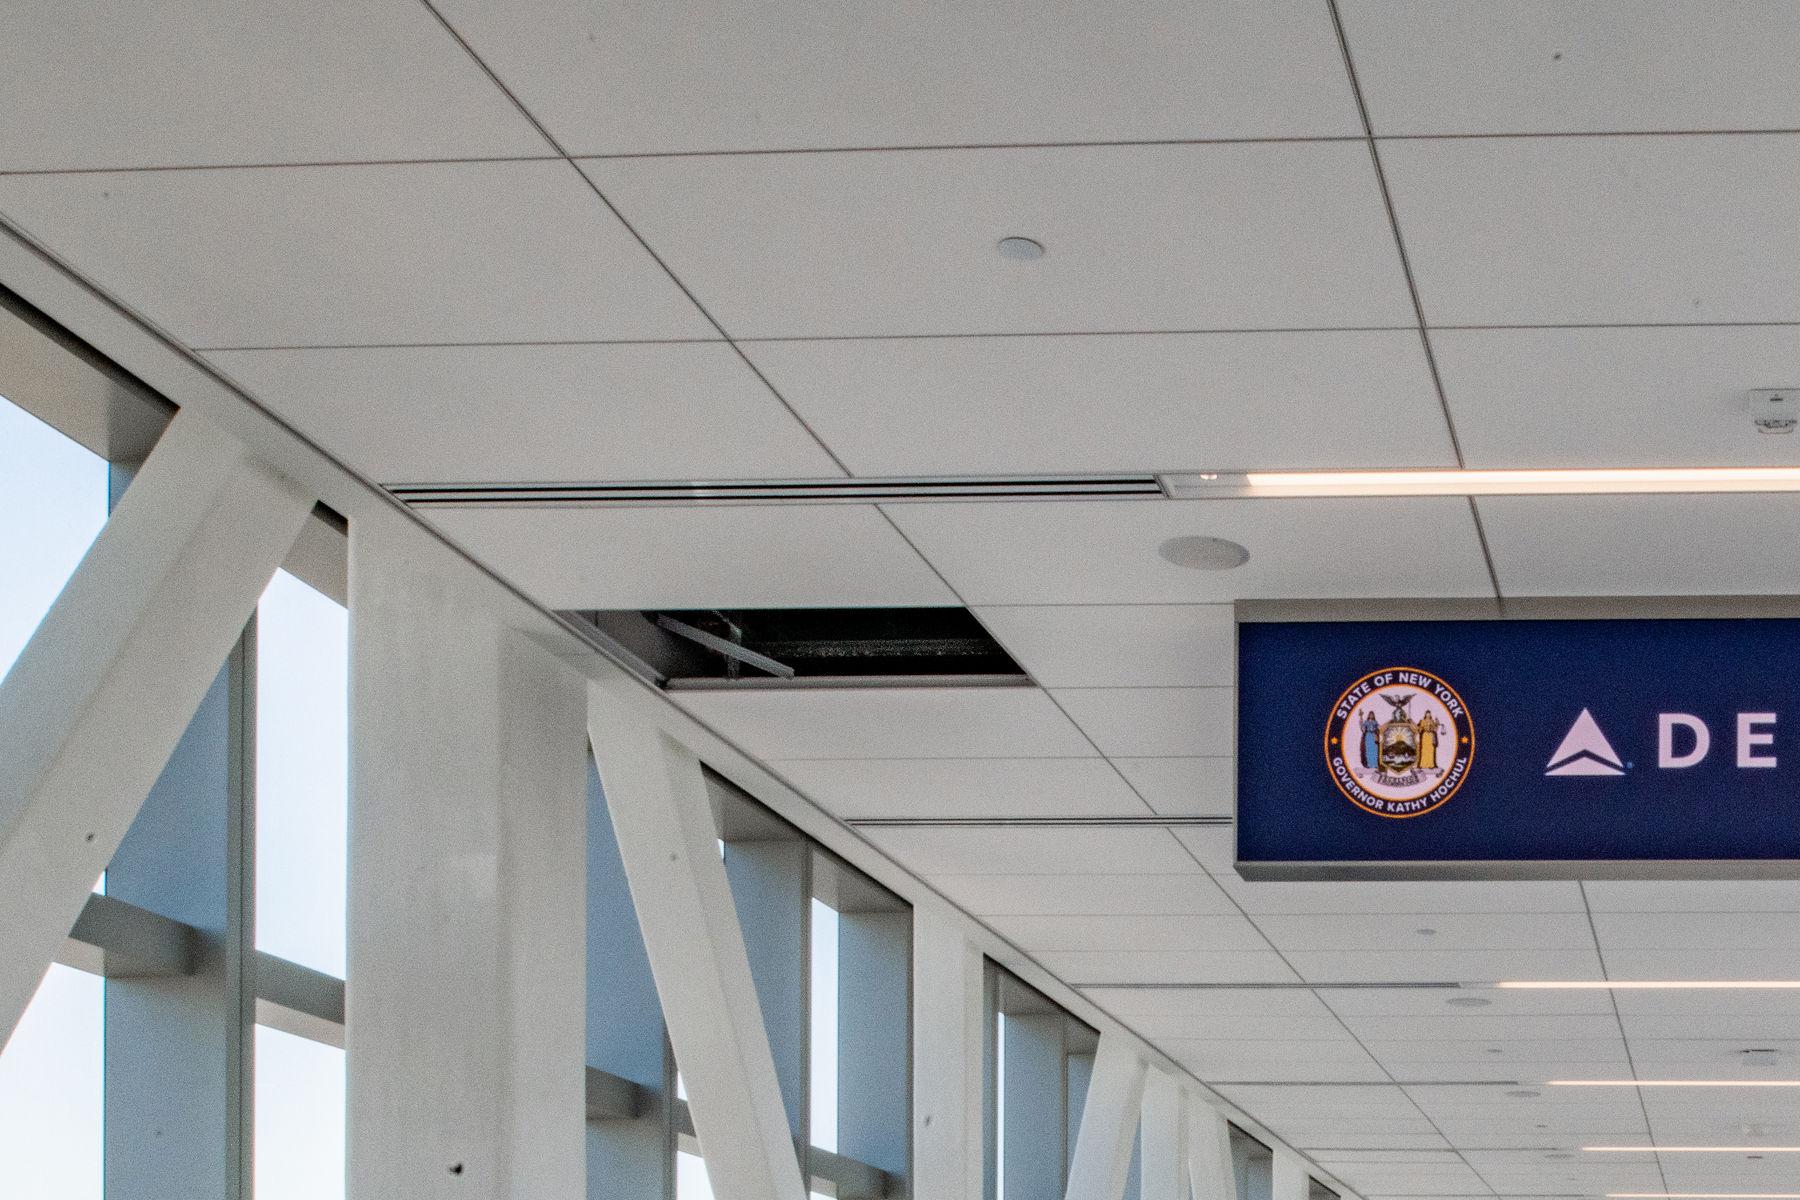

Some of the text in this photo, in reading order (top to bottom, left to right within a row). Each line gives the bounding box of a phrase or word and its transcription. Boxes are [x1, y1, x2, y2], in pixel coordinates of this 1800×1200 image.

[1336, 672, 1464, 720] STATE OF NEW YORK
[1332, 757, 1467, 813] GOVERNOR KATHY HOCHUL
